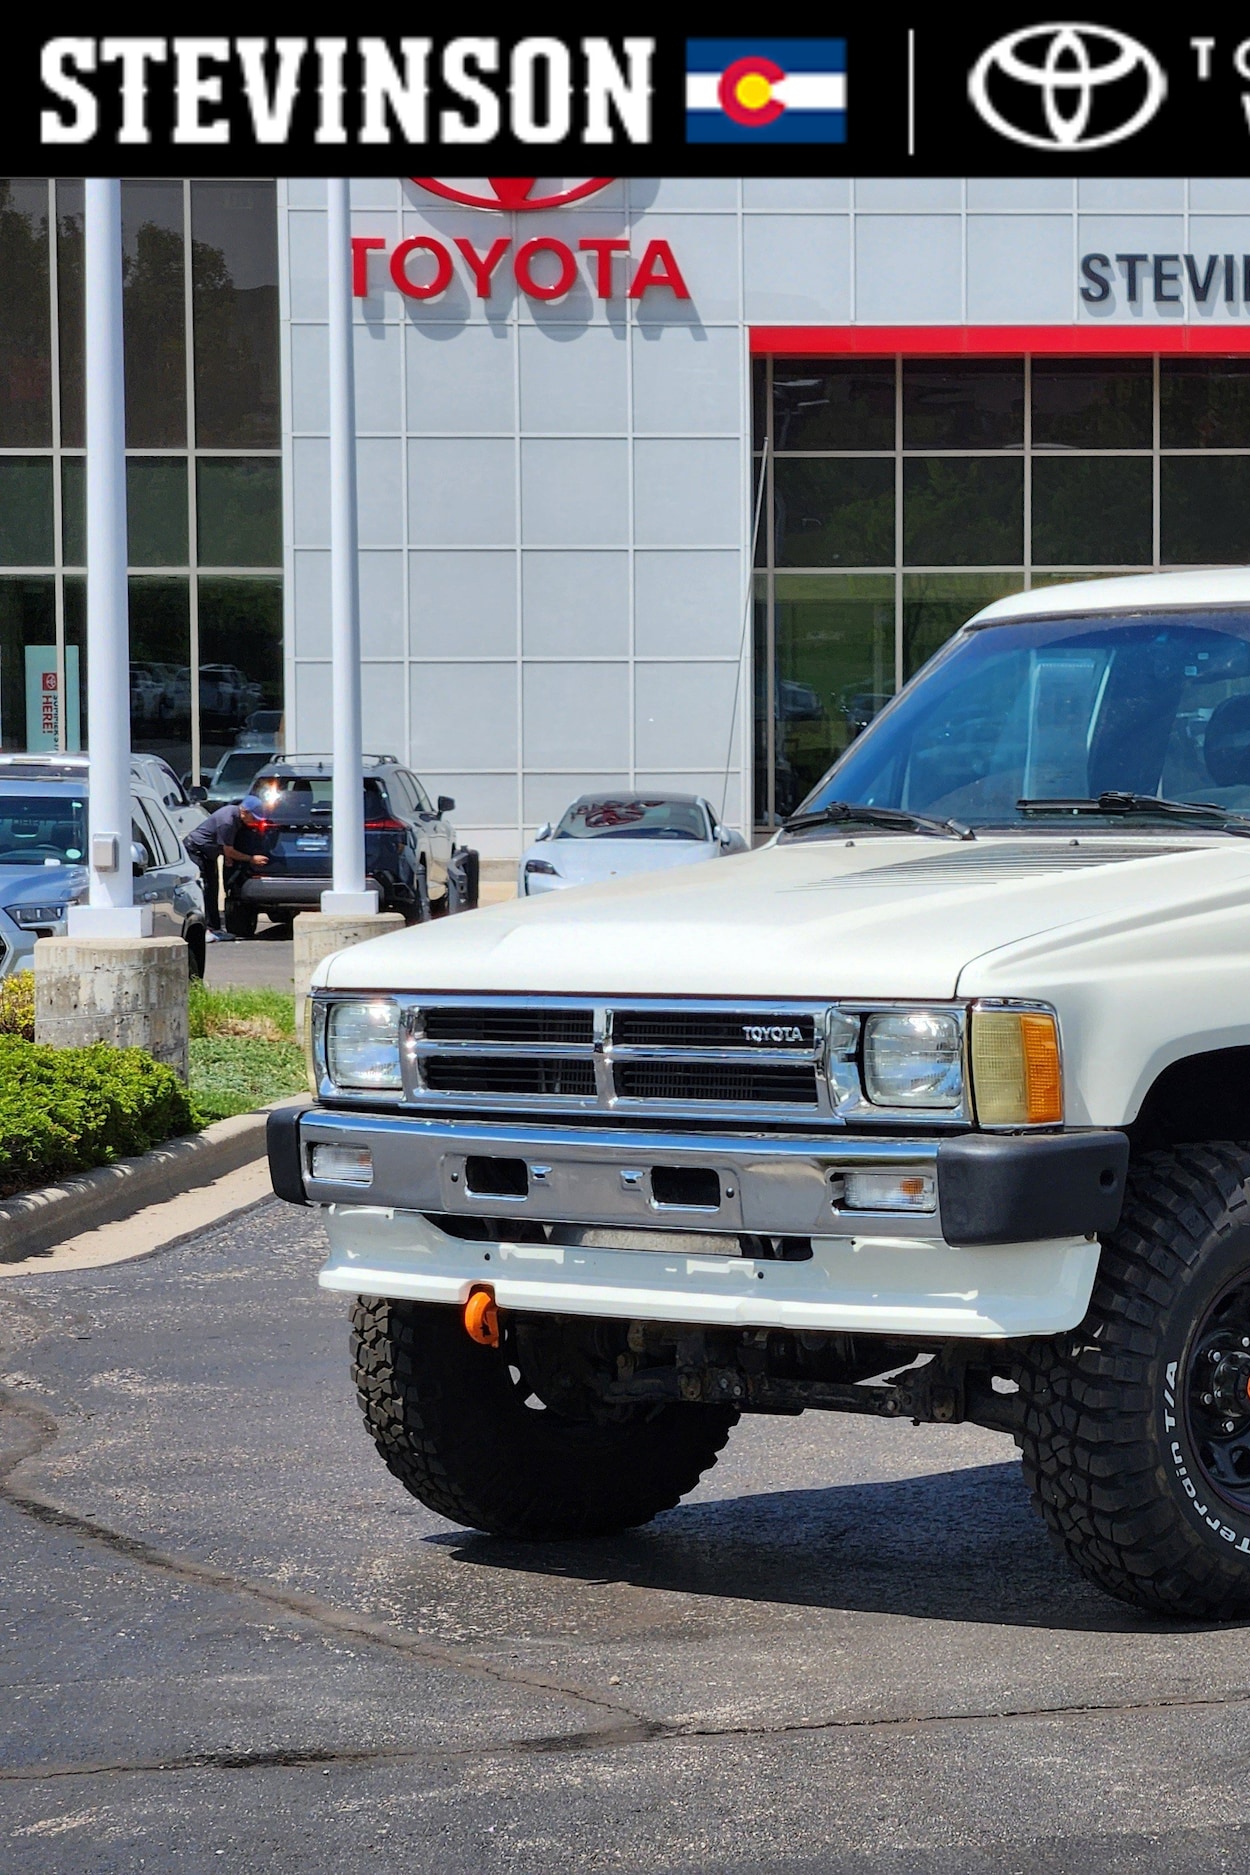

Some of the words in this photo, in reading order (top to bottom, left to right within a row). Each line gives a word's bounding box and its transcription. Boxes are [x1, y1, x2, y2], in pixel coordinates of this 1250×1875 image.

[352, 236, 690, 300] TOYOTA
[42, 695, 53, 734] HERE!
[742, 1026, 804, 1042] TOYOTA
[1164, 1361, 1178, 1433] T/A
